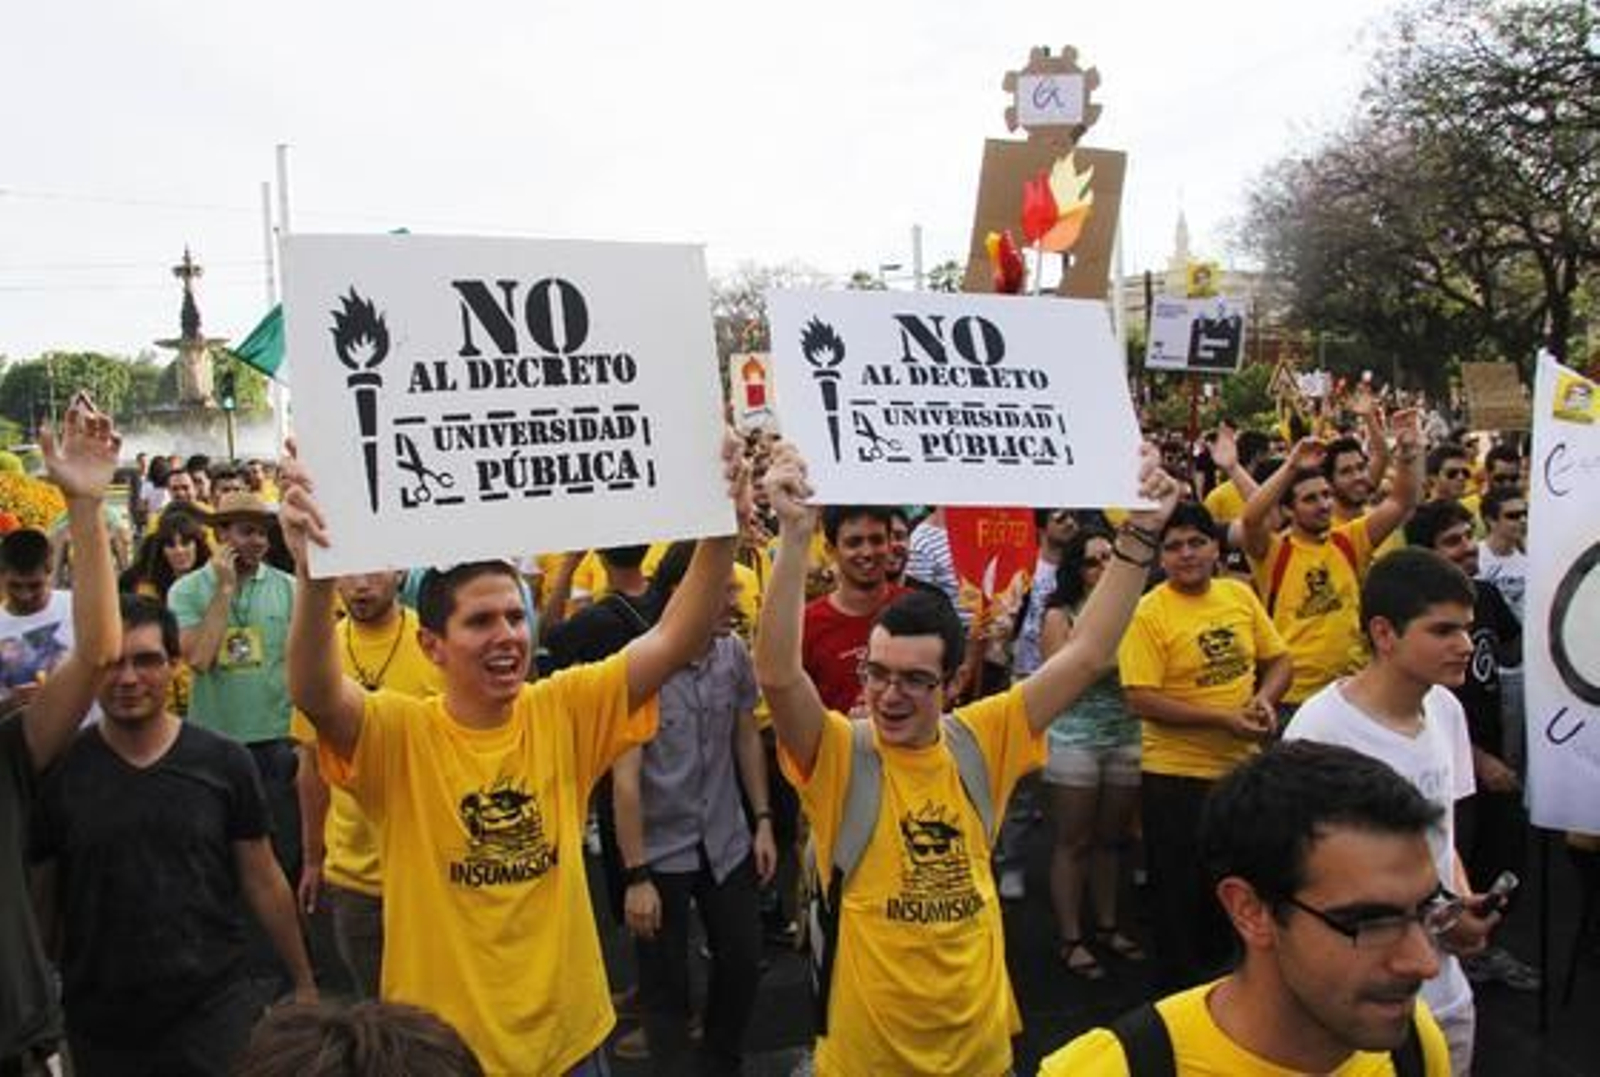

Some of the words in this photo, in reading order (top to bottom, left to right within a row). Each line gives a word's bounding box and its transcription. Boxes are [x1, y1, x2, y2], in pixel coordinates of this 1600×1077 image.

[451, 278, 590, 357] NO
[893, 314, 1006, 366] NO
[407, 360, 458, 394] AL
[467, 353, 638, 391] DECRETO
[861, 364, 901, 386] AL
[909, 365, 1050, 389] DECRETO
[432, 415, 638, 452] UNIVERSIDAD
[883, 408, 1053, 429] UNIVERSIDAD
[919, 427, 1059, 458] PÚBLICA
[475, 449, 641, 492] PÚBLICA
